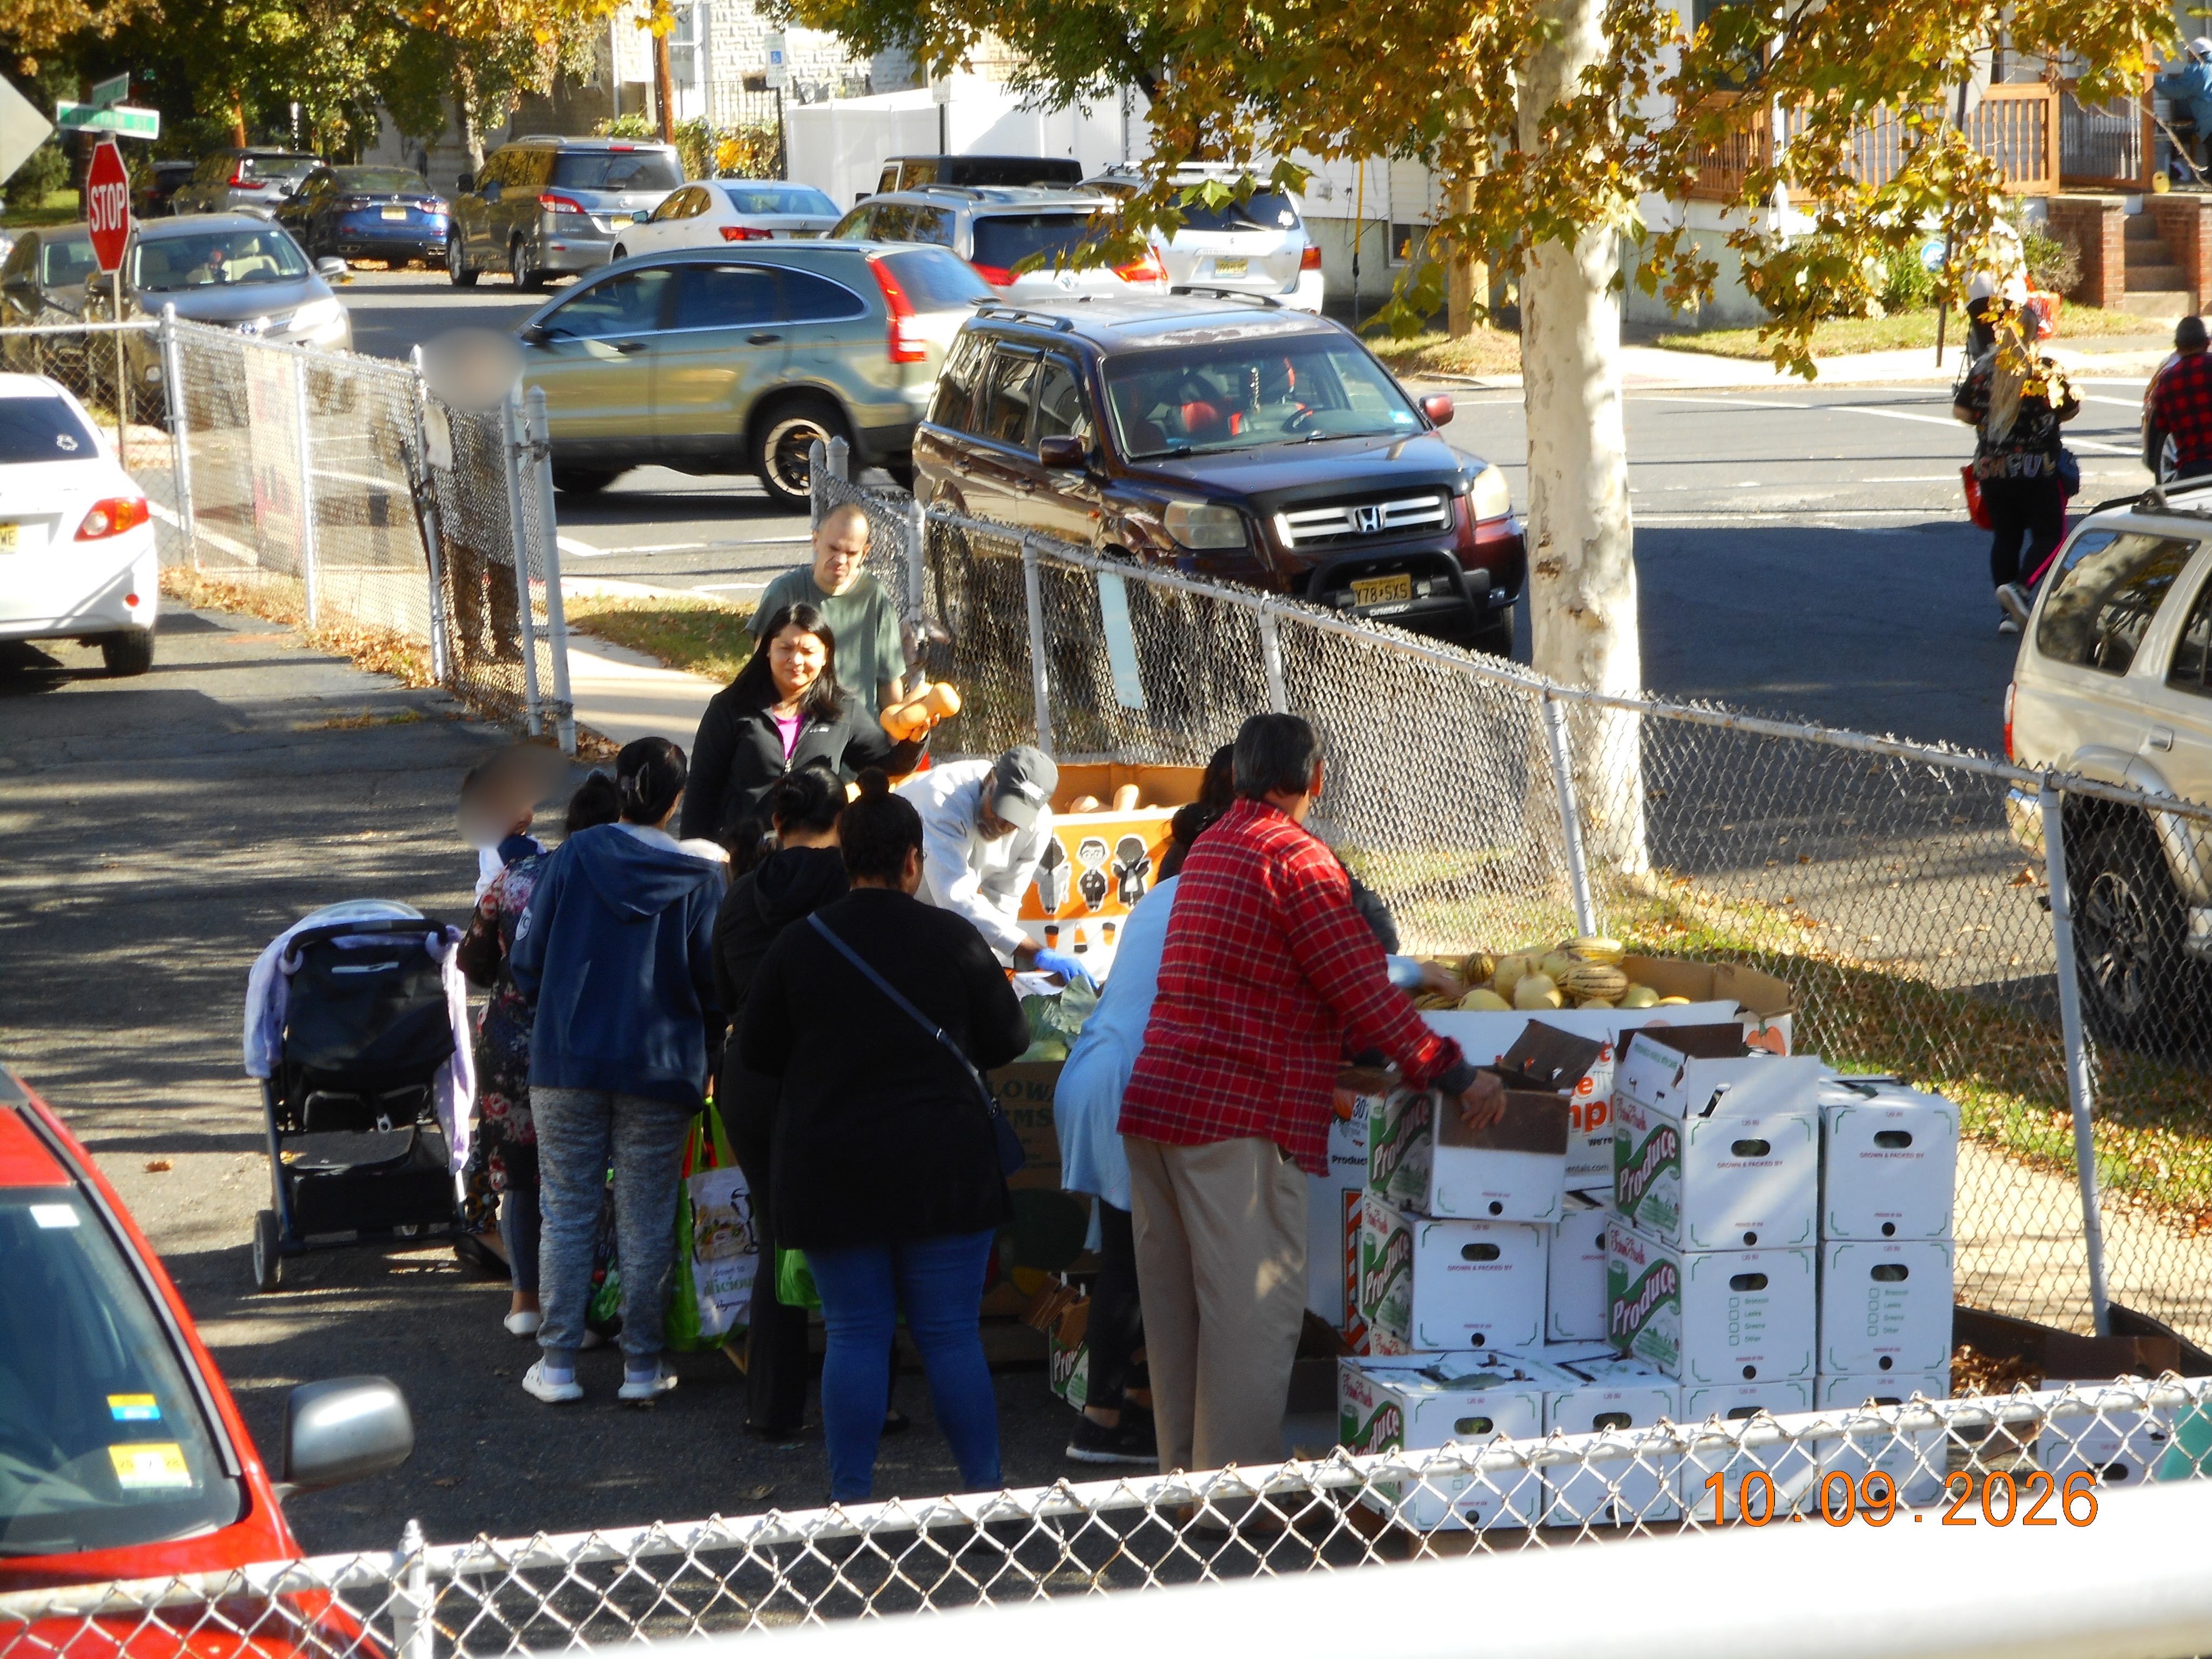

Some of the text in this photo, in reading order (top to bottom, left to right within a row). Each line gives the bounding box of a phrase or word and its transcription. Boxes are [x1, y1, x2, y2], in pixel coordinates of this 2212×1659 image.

[90, 182, 125, 232] STOP
[1619, 1130, 1675, 1204] Produce
[1365, 1232, 1409, 1305] Produce
[1612, 1266, 1675, 1335] Produce
